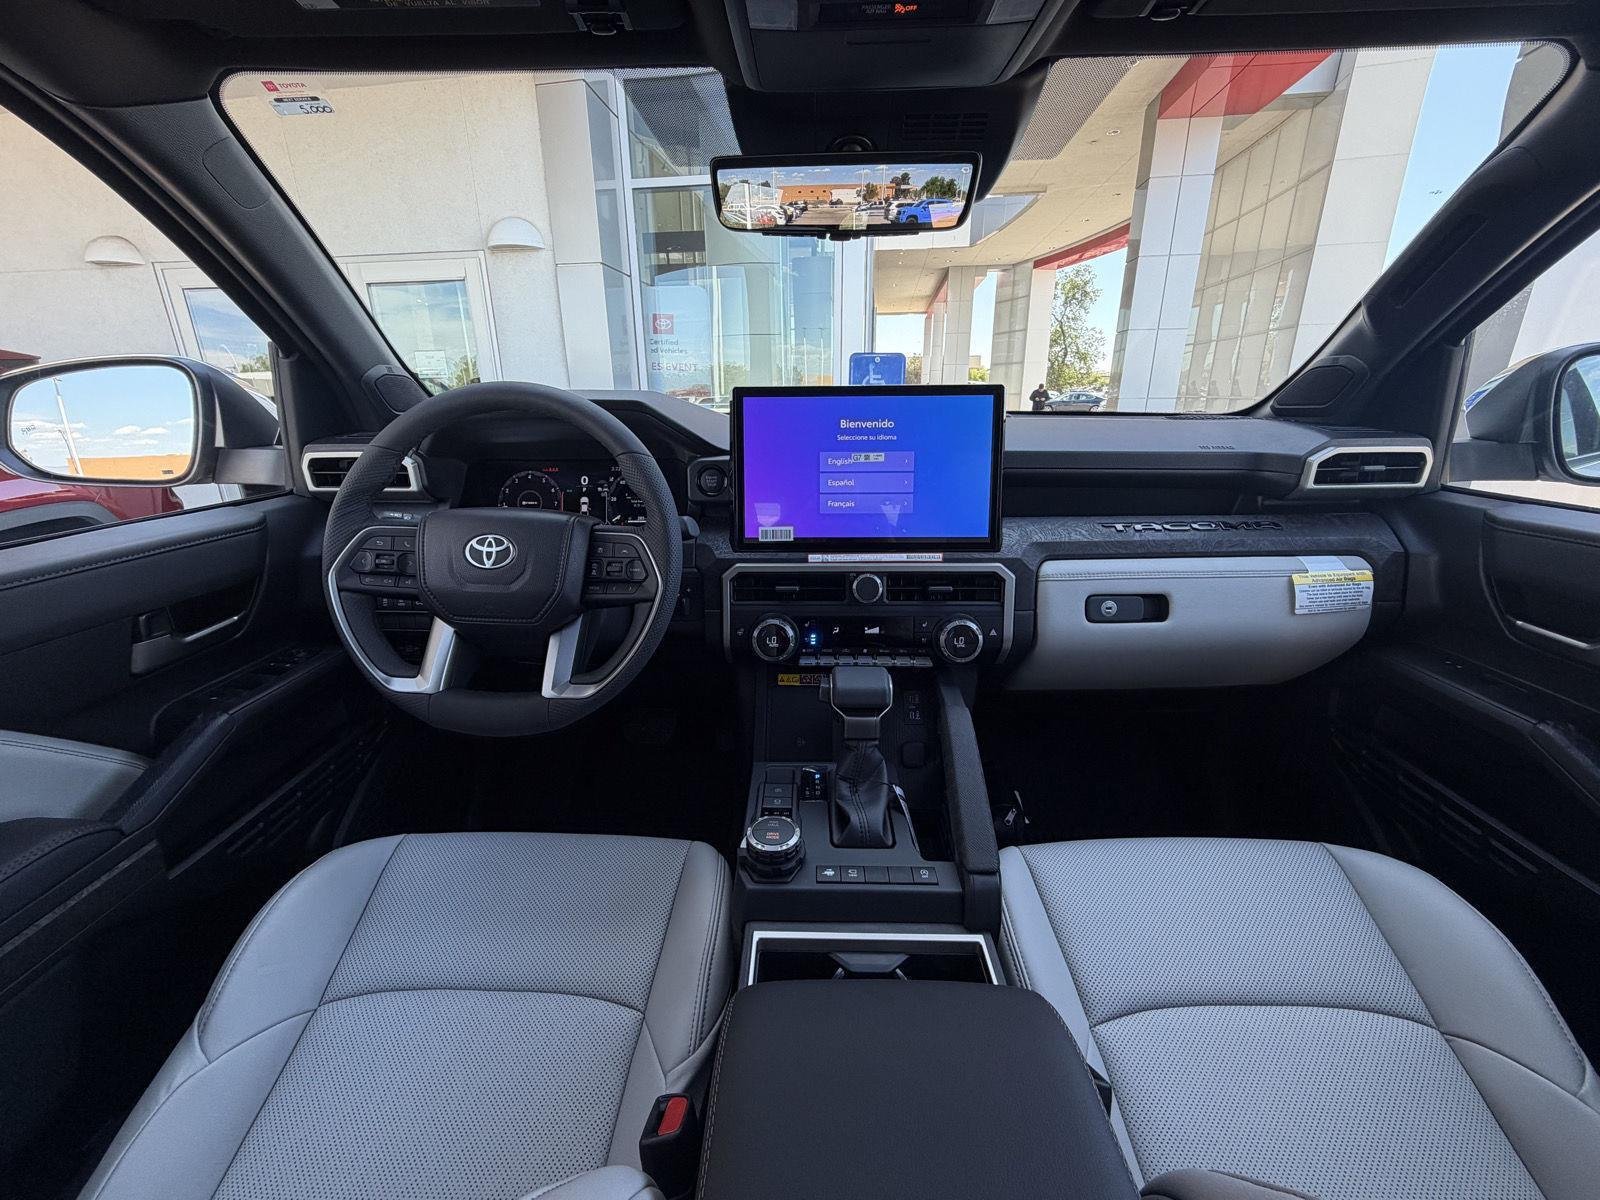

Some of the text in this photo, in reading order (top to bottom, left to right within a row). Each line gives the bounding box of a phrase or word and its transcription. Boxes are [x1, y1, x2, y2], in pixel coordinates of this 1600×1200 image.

[665, 362, 698, 371] EVENT
[840, 419, 895, 429] Bienvenido
[828, 457, 853, 466] English
[580, 475, 589, 485] 0
[828, 479, 855, 488] Español
[828, 500, 855, 508] Français
[1098, 520, 1283, 532] TACOMA
[766, 636, 777, 645] LO
[953, 636, 965, 645] LO
